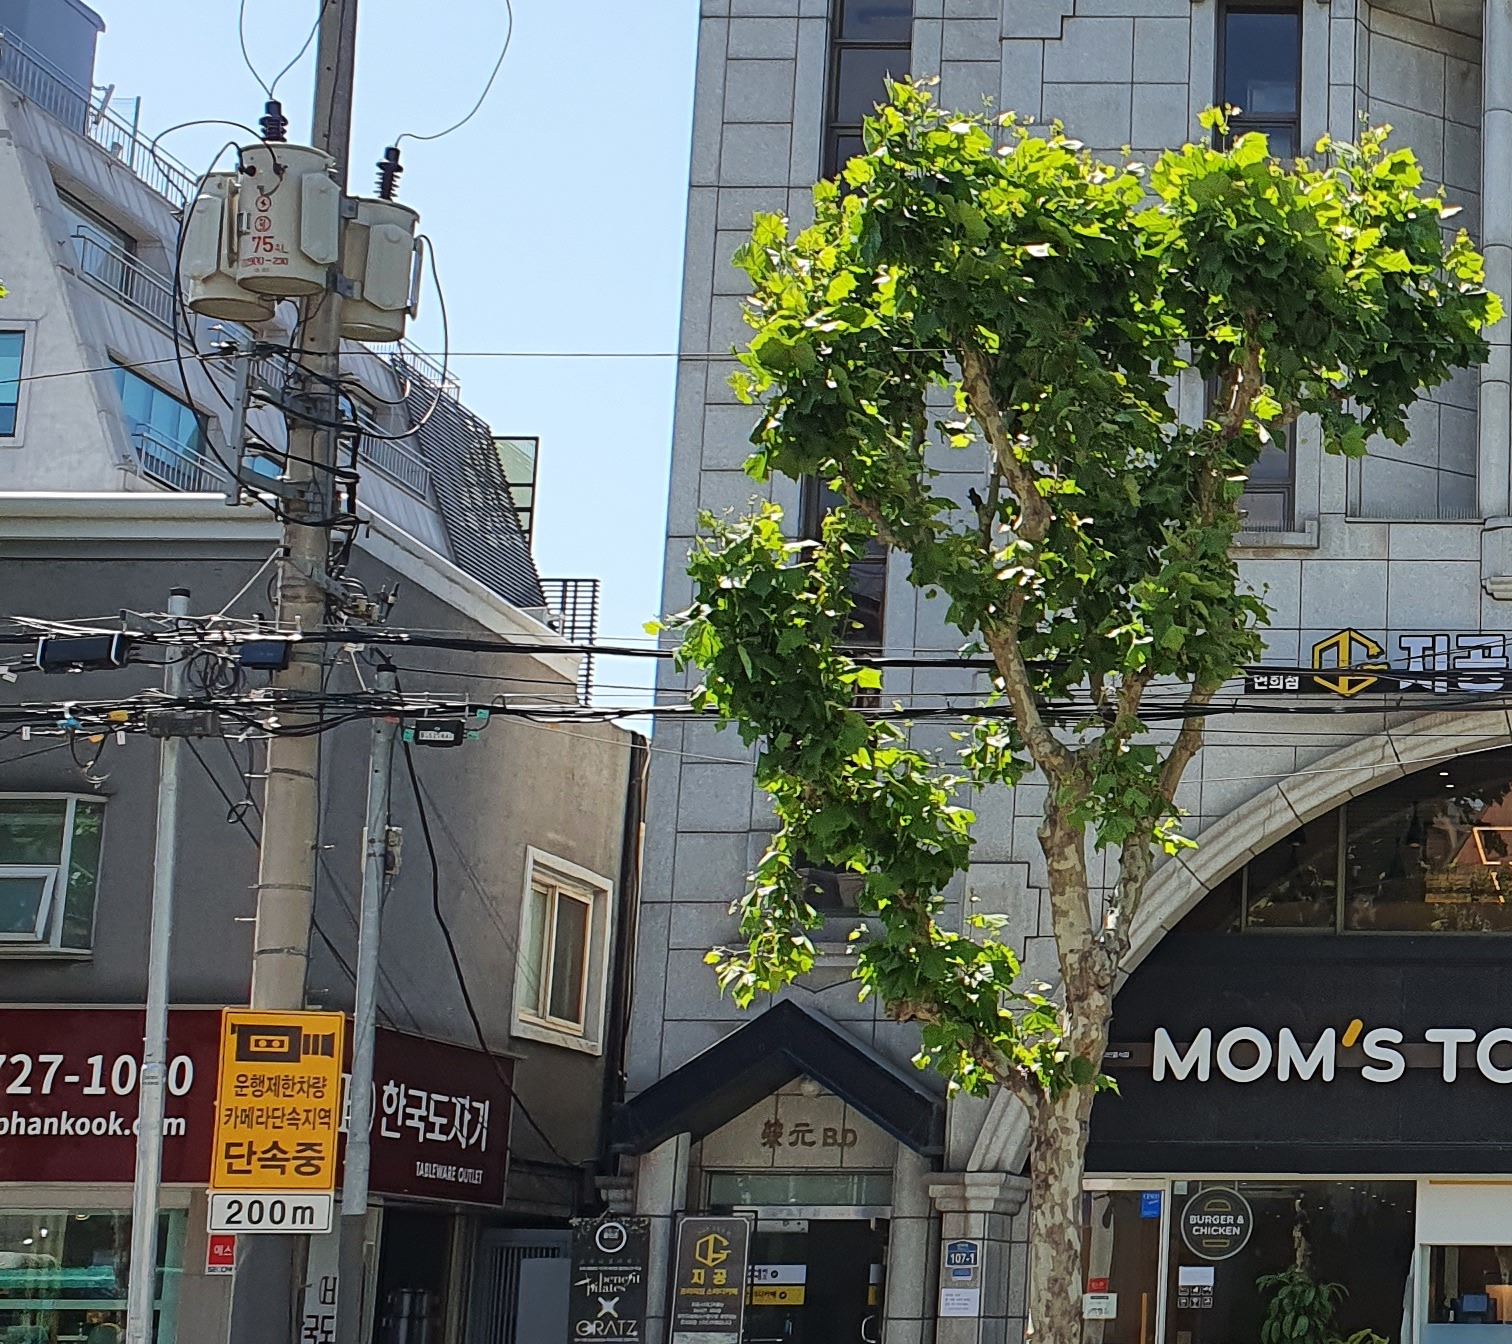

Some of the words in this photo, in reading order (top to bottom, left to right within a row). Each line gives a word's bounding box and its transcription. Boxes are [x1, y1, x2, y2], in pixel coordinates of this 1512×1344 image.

[252, 236, 274, 254] 75
[1399, 634, 1509, 693] 지공
[1153, 1019, 1406, 1083] MOM'S
[0, 1053, 194, 1096] 27-100
[233, 1073, 328, 1099] 운행제한차량
[223, 1106, 332, 1131] 카메라단속지역
[380, 1079, 490, 1153] 한국도자기
[224, 1140, 326, 1177] 단속중
[416, 1161, 456, 1182] TABLEWARE
[457, 1167, 484, 1185] OUTLET
[225, 1199, 315, 1225] 200m
[1189, 1215, 1235, 1225] BURGER
[1192, 1226, 1241, 1236] CHICKEN
[950, 1252, 975, 1264] 107-1
